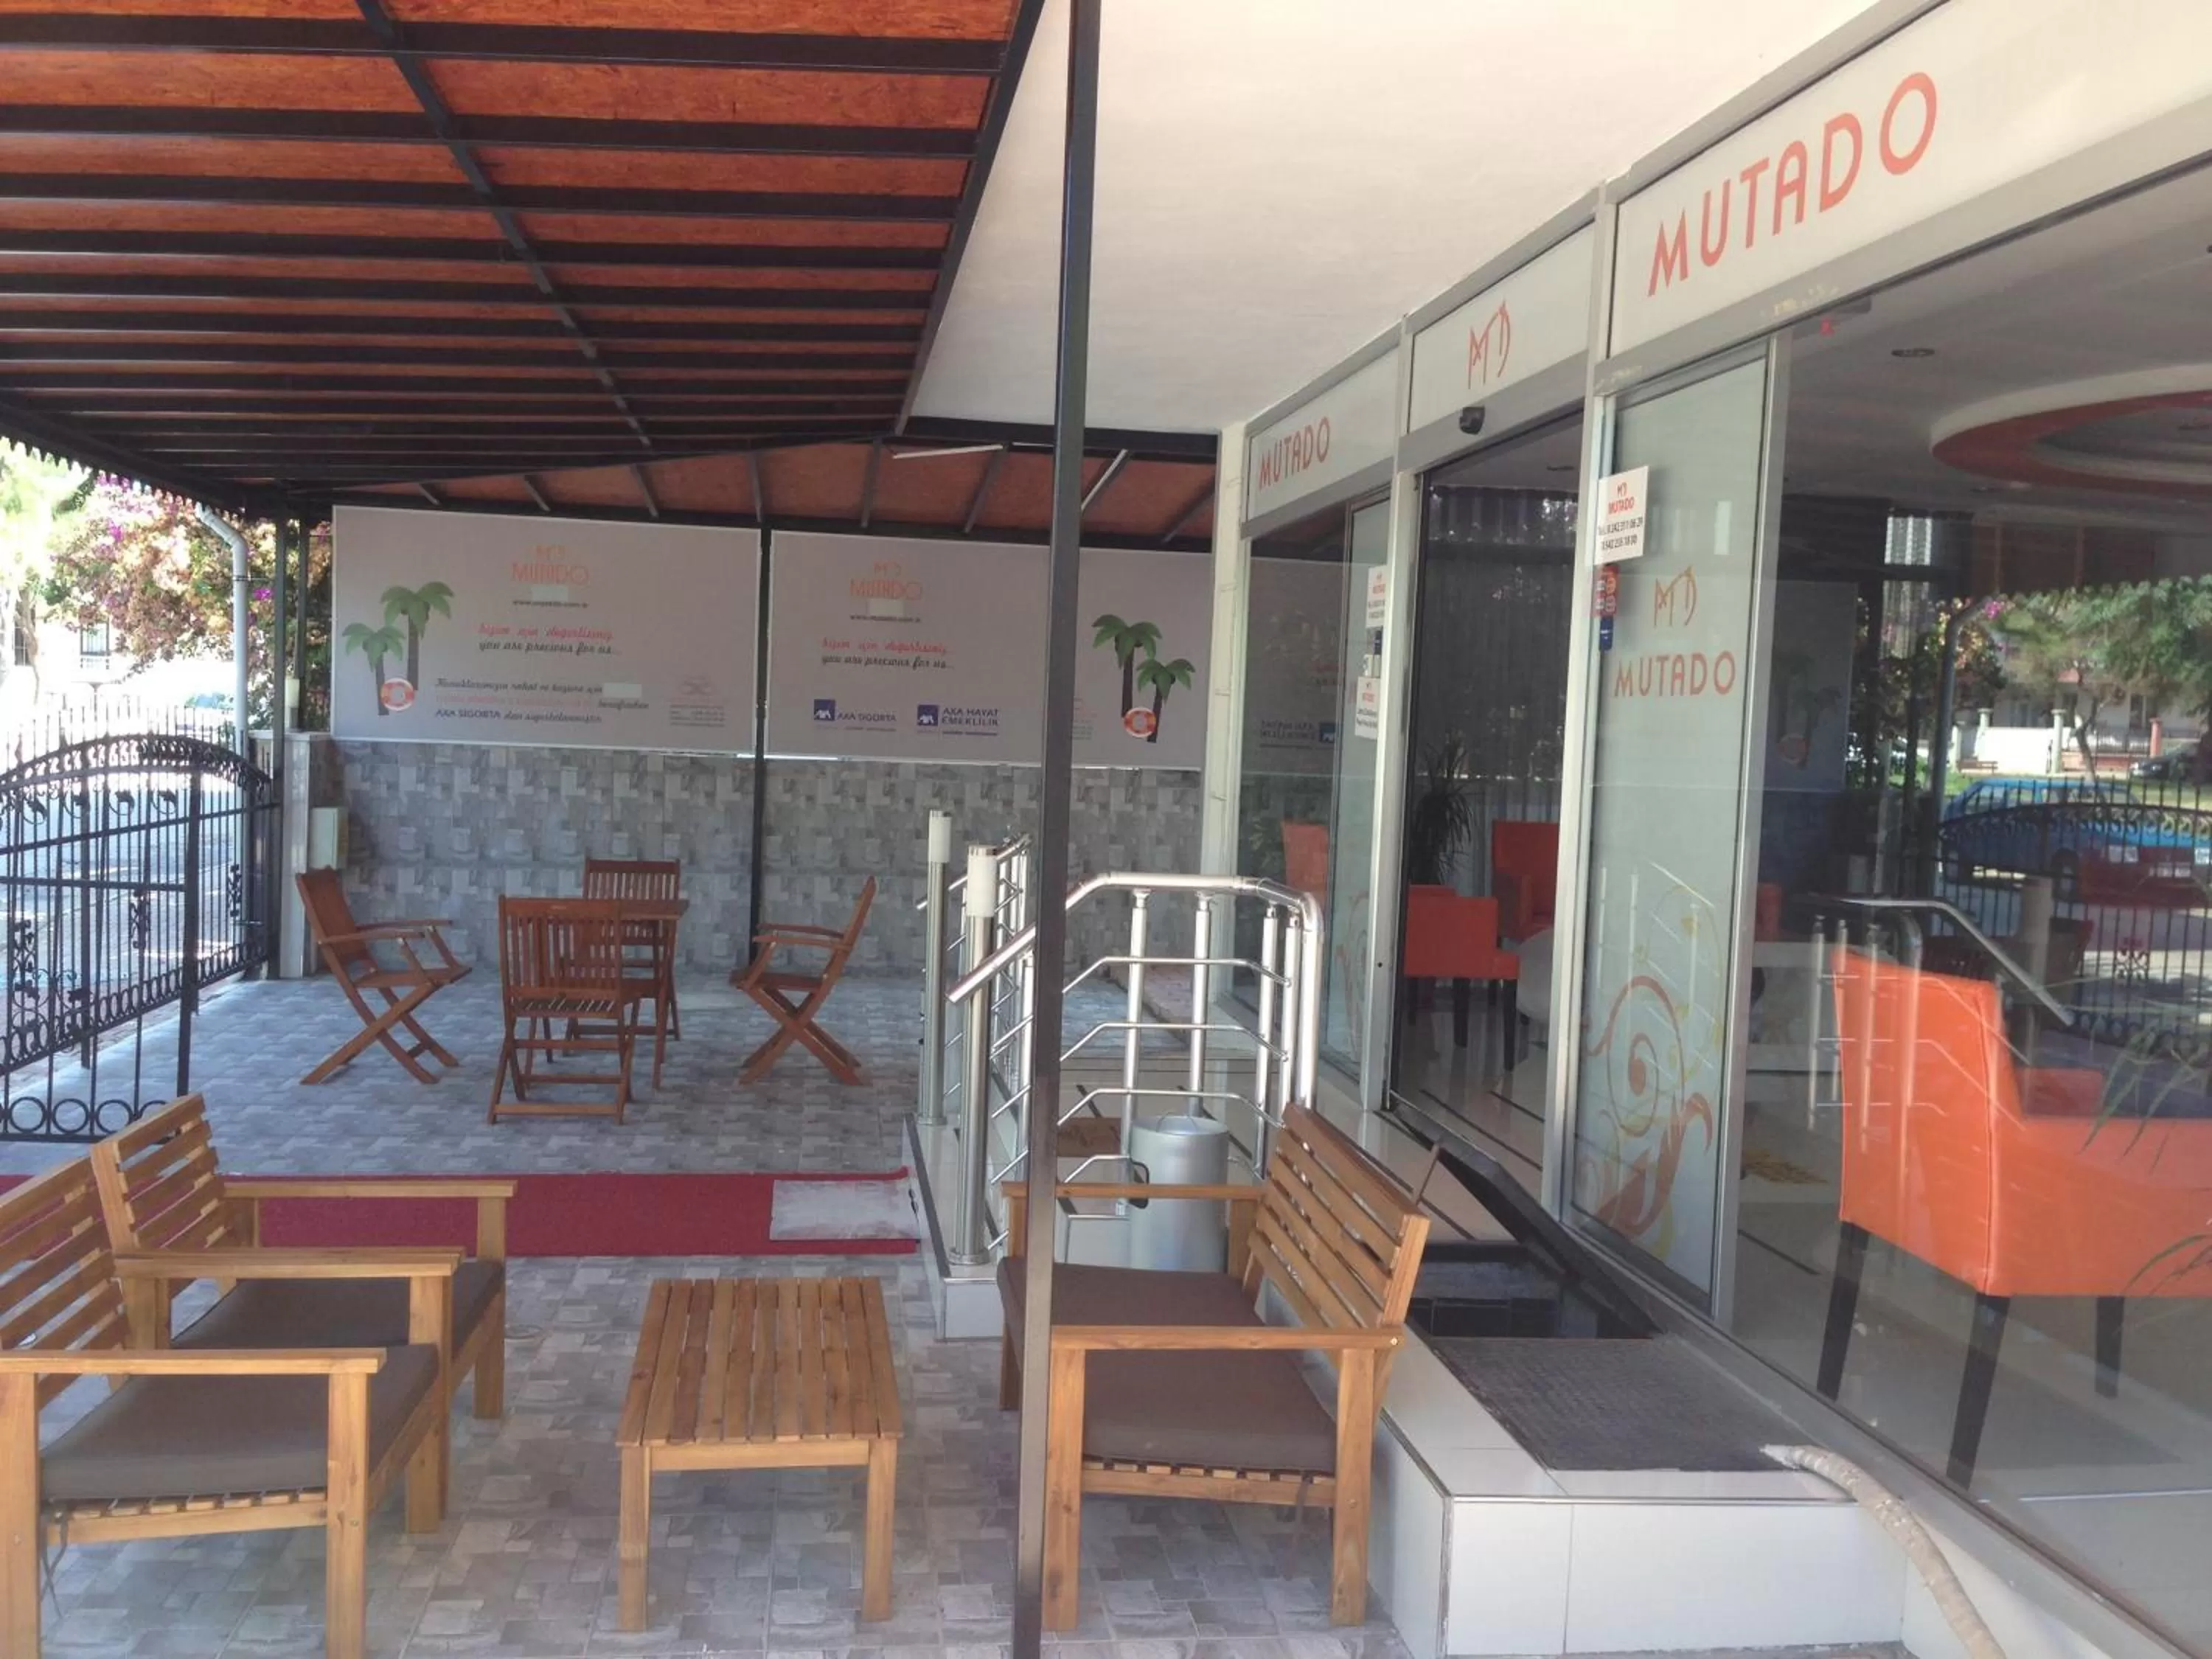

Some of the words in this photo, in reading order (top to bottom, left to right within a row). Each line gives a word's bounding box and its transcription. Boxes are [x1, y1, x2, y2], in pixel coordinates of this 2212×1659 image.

[1647, 72, 1937, 297] MUTADO
[1259, 417, 1330, 491] MUTADO
[1615, 650, 1736, 696] MUTADO
[966, 708, 999, 717] HAYAT
